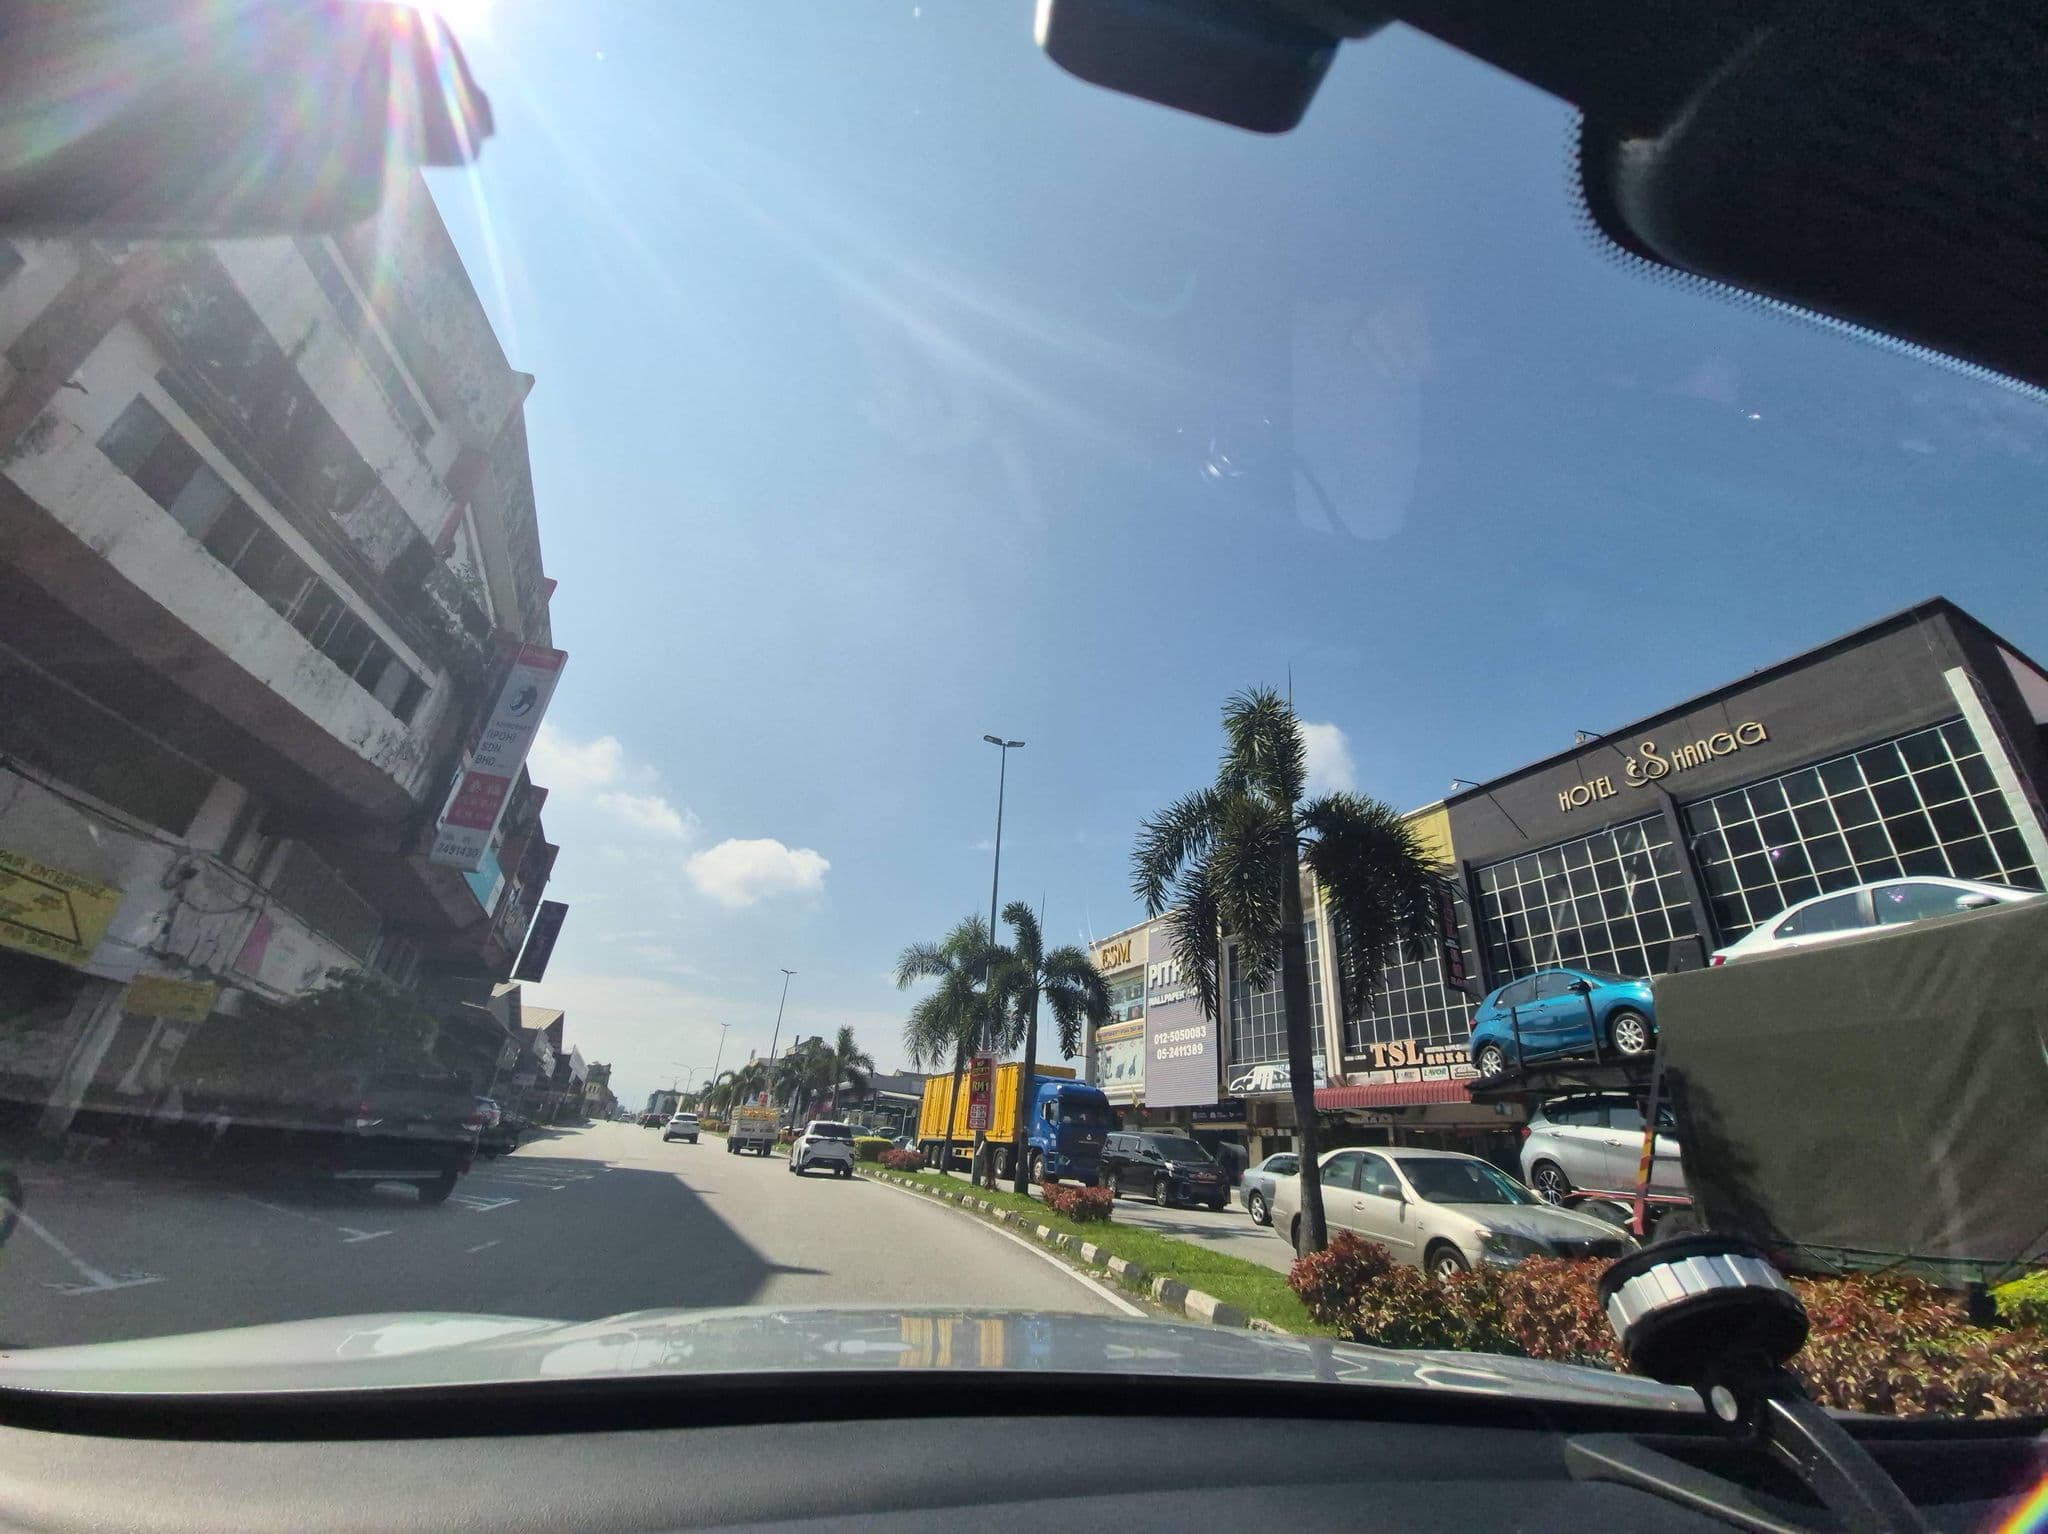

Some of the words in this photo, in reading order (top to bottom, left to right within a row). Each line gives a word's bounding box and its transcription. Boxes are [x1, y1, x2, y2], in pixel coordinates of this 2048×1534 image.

[1558, 775, 1618, 812] HOTEL
[1101, 939, 1132, 971] ESM
[1157, 1042, 1203, 1060] 05-2411389
[1370, 1039, 1424, 1068] TSL
